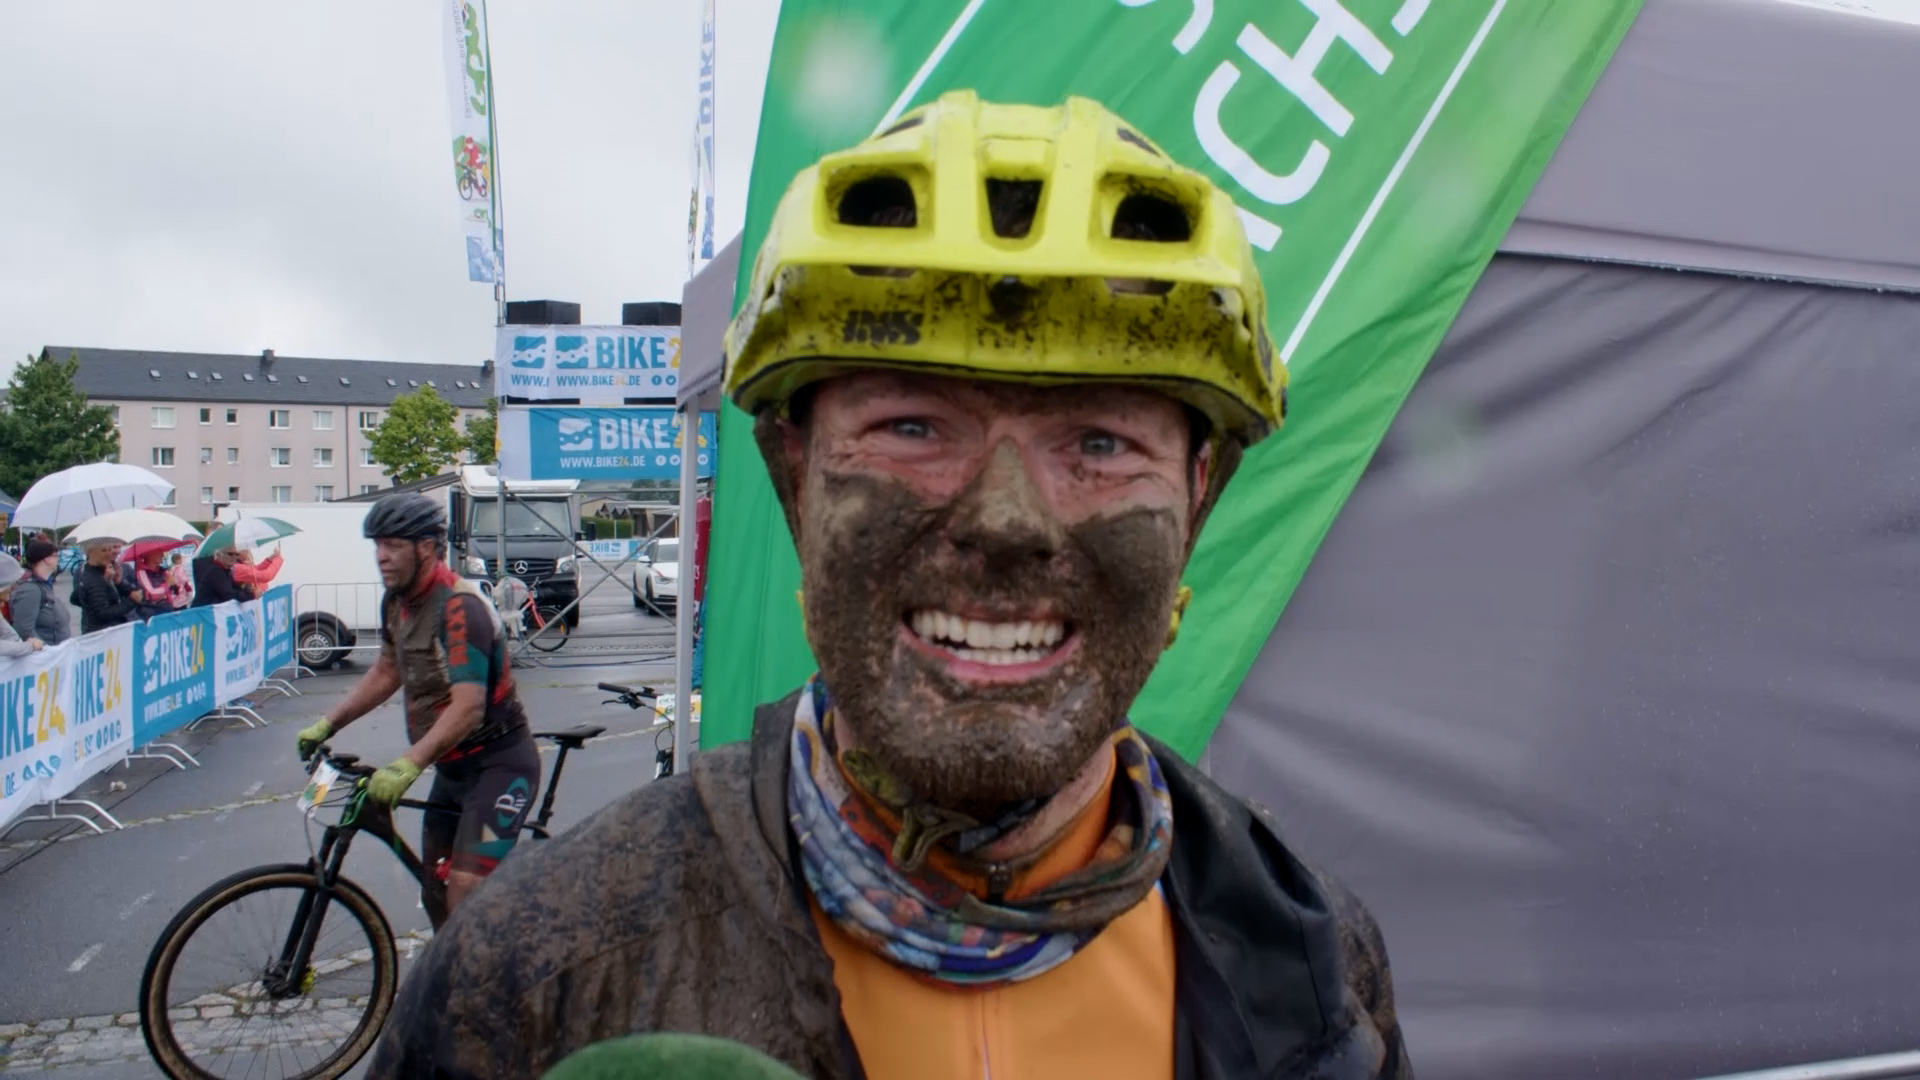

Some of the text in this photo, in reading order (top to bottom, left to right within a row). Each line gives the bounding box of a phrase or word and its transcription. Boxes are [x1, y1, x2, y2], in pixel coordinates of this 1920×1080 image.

[556, 375, 641, 387] WWW.BIKE24.DE
[560, 456, 645, 468] WWW.BIKE24.DE
[160, 622, 205, 687] BIKE24
